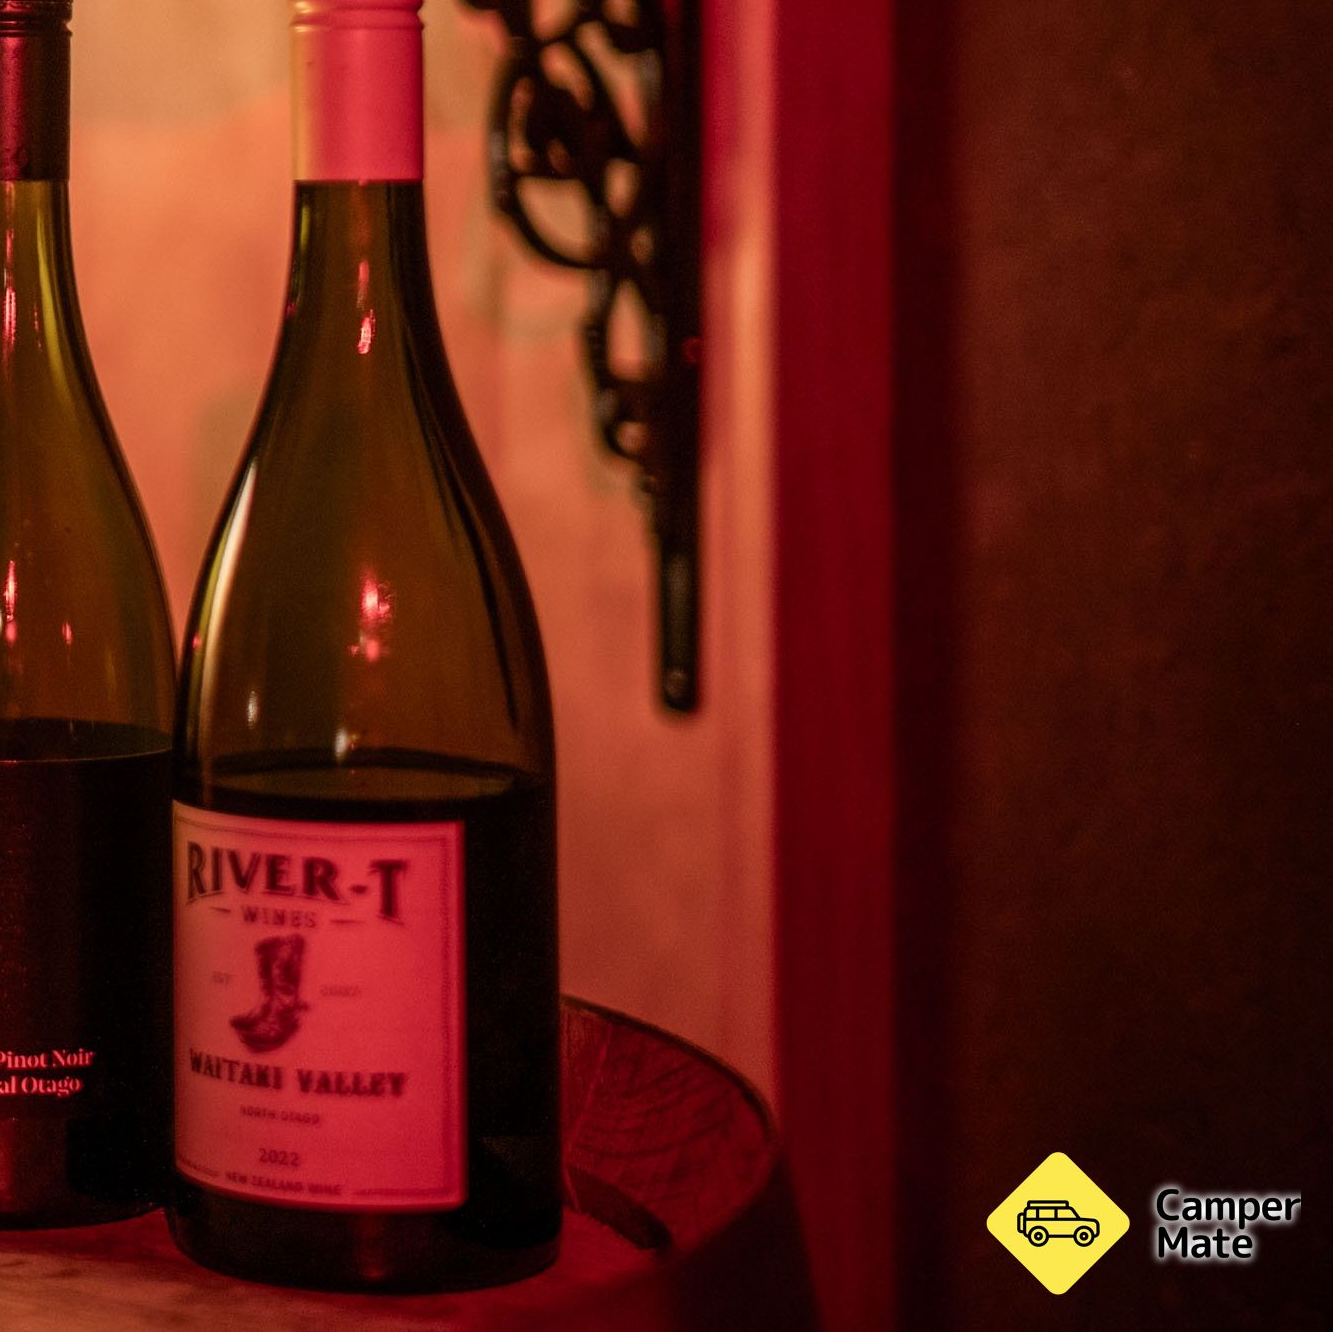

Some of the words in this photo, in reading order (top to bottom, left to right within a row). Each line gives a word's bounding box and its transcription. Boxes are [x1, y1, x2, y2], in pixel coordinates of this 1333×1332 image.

[185, 840, 408, 925] RIVER-T
[240, 905, 319, 930] WINES
[51, 1048, 95, 1068] Noir
[20, 1074, 84, 1099] Otago
[297, 1068, 408, 1100] VALLEY
[258, 1147, 301, 1168] 2022
